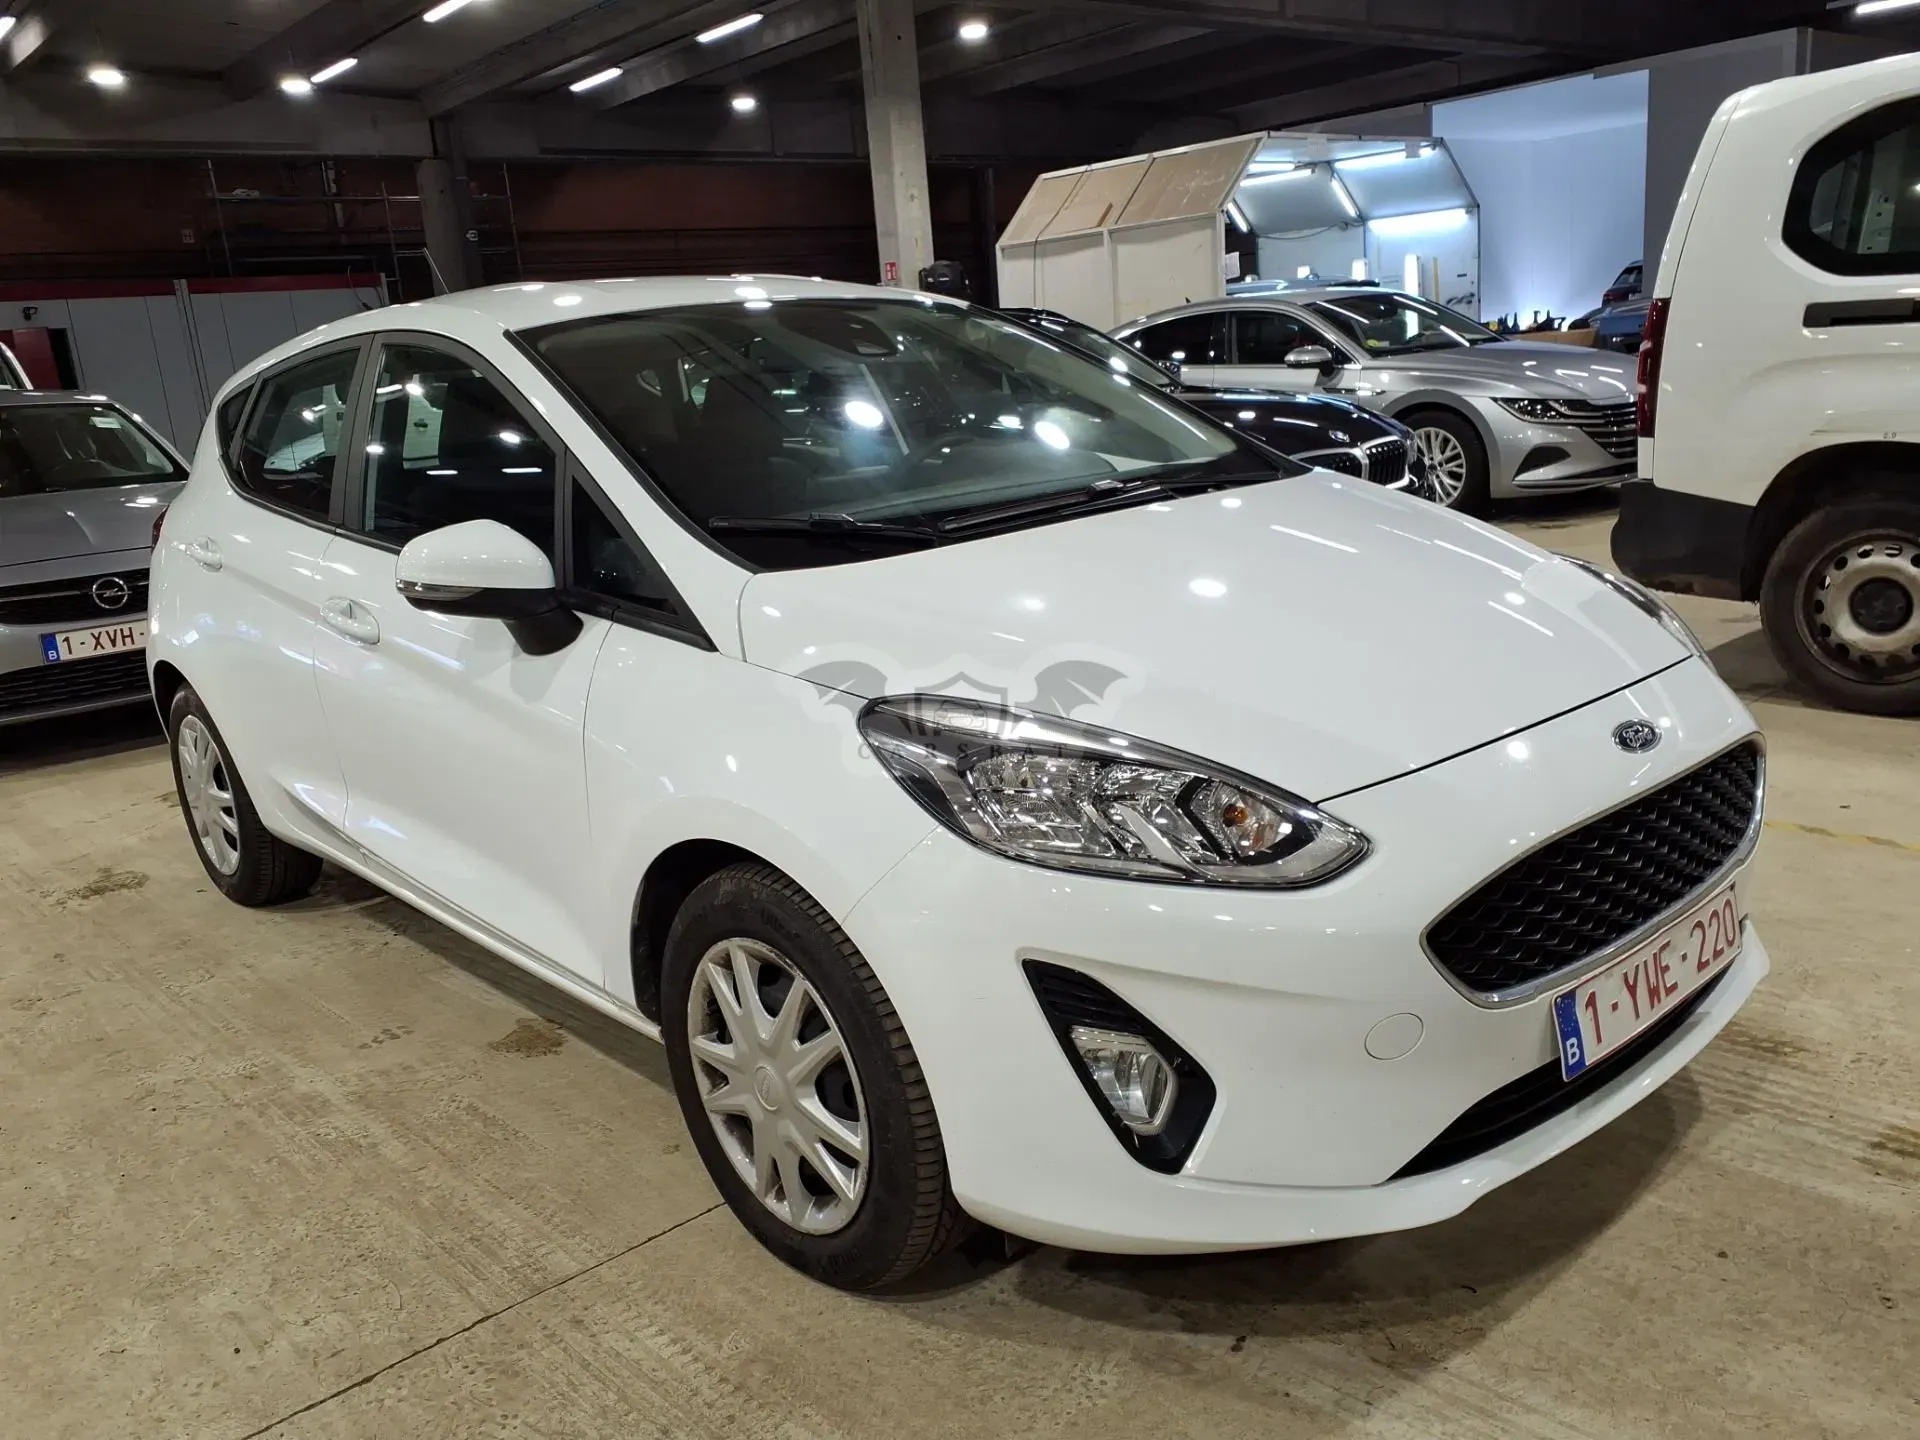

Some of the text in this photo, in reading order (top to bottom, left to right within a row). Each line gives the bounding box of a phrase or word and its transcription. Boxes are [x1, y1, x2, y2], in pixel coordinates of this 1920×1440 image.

[48, 650, 58, 660] B
[62, 626, 145, 655] 1-XVH-
[1622, 724, 1653, 748] Ford
[1584, 897, 1736, 1048] 1-YWE-220
[1565, 1036, 1580, 1066] B
